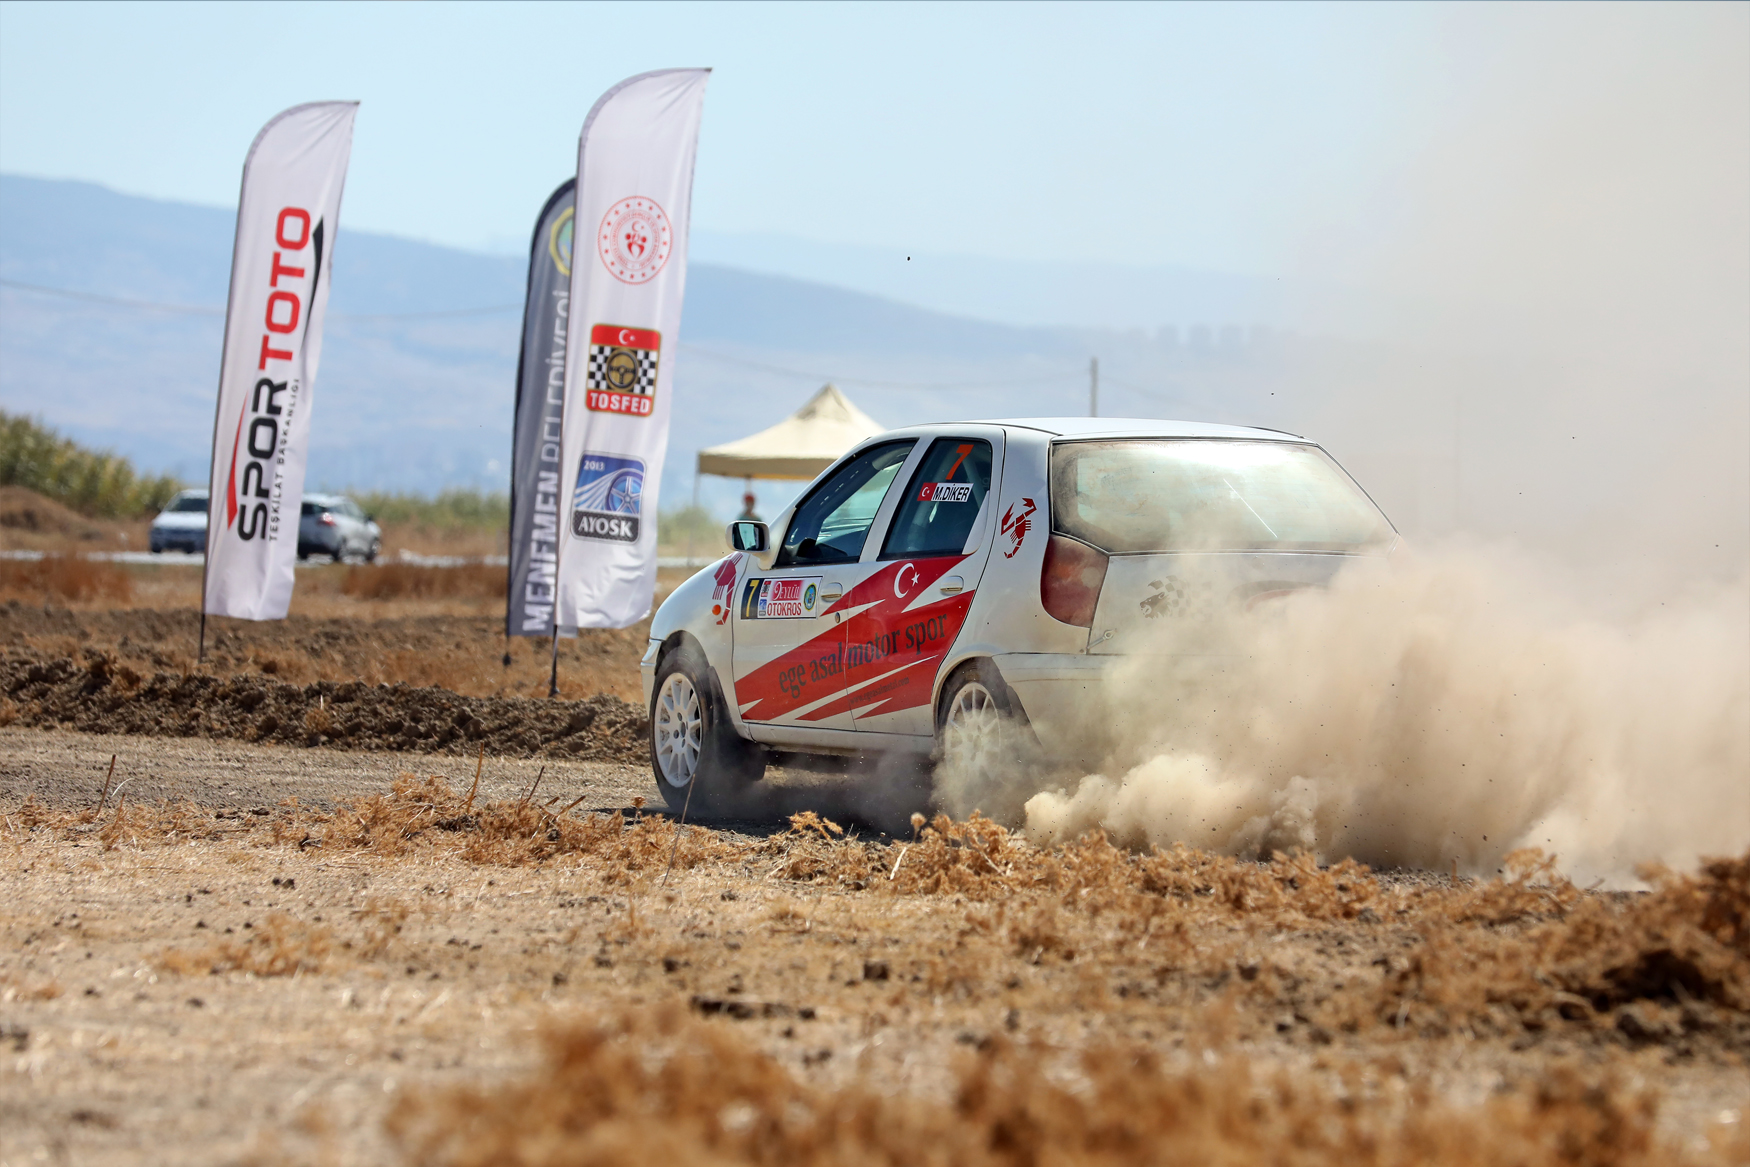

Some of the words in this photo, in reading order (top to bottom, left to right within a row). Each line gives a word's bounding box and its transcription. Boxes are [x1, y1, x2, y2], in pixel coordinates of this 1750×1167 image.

[258, 206, 311, 370] TOTO
[590, 392, 651, 414] TOSFED
[237, 377, 288, 541] SPOR
[583, 460, 605, 471] 2013
[945, 444, 974, 480] 7
[578, 516, 633, 537] AYOSK
[745, 580, 760, 617] 7
[767, 602, 802, 616] OTOKROS
[778, 664, 807, 699] ege
[810, 642, 843, 682] asal
[848, 629, 900, 669] motor
[905, 613, 948, 655] spor
